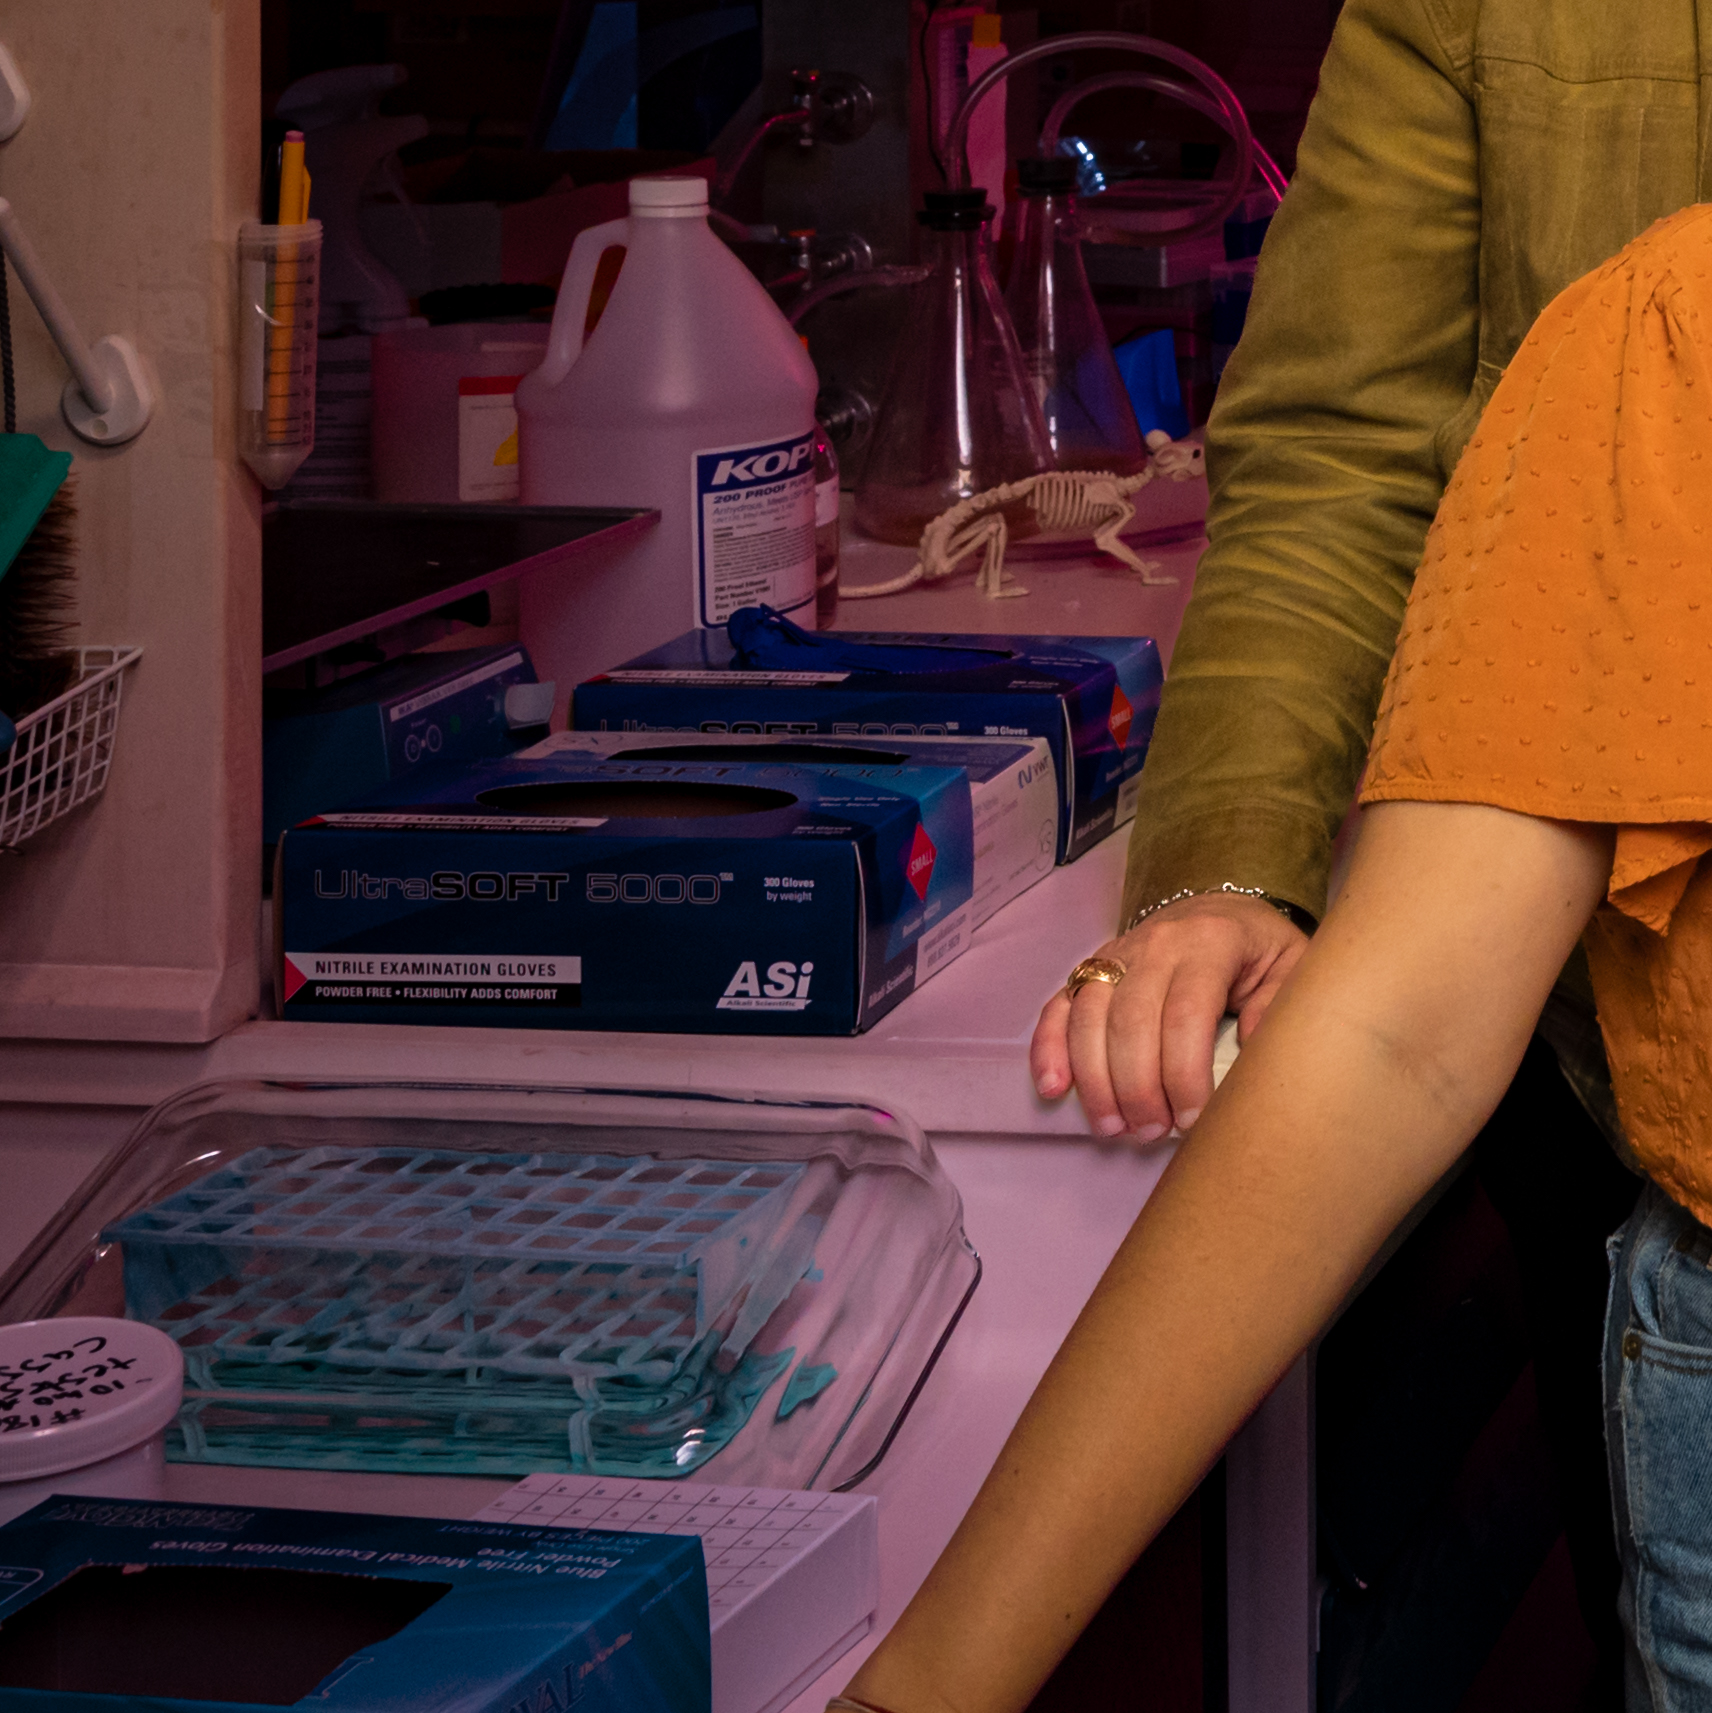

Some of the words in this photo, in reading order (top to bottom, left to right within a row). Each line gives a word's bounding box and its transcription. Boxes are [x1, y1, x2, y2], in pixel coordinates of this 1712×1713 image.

[710, 442, 814, 487] KOP
[713, 493, 741, 504] 200
[745, 484, 788, 500] PROOF
[1111, 709, 1131, 729] SMALL
[1000, 726, 1028, 735] Gloves
[911, 850, 933, 876] SMALL
[314, 869, 570, 902] UltraSOFT
[763, 876, 780, 888] 300
[781, 876, 815, 888] Gloves
[766, 890, 779, 902] by
[779, 890, 813, 903] weight
[315, 960, 376, 975] NITRILE
[380, 961, 492, 976] EXAMINATION
[499, 963, 557, 978] GLOVES
[722, 960, 815, 998] ASi
[315, 986, 364, 999] POWDER
[366, 987, 393, 999] FREE
[403, 987, 468, 999] FLEXIBILITY
[470, 988, 502, 1000] ADDS
[504, 988, 558, 1001] COMFORT
[726, 999, 753, 1007] Alkali
[754, 999, 797, 1008] Scientific
[435, 1524, 513, 1537] WEIGHT
[517, 1530, 543, 1538] BY
[147, 1538, 230, 1555] Gloves
[232, 1541, 378, 1562] Examination
[476, 1547, 528, 1562] Free
[379, 1552, 473, 1570] Medical
[477, 1559, 549, 1575] Nitrile
[531, 1551, 622, 1568] Powder
[554, 1564, 608, 1580] Blue
